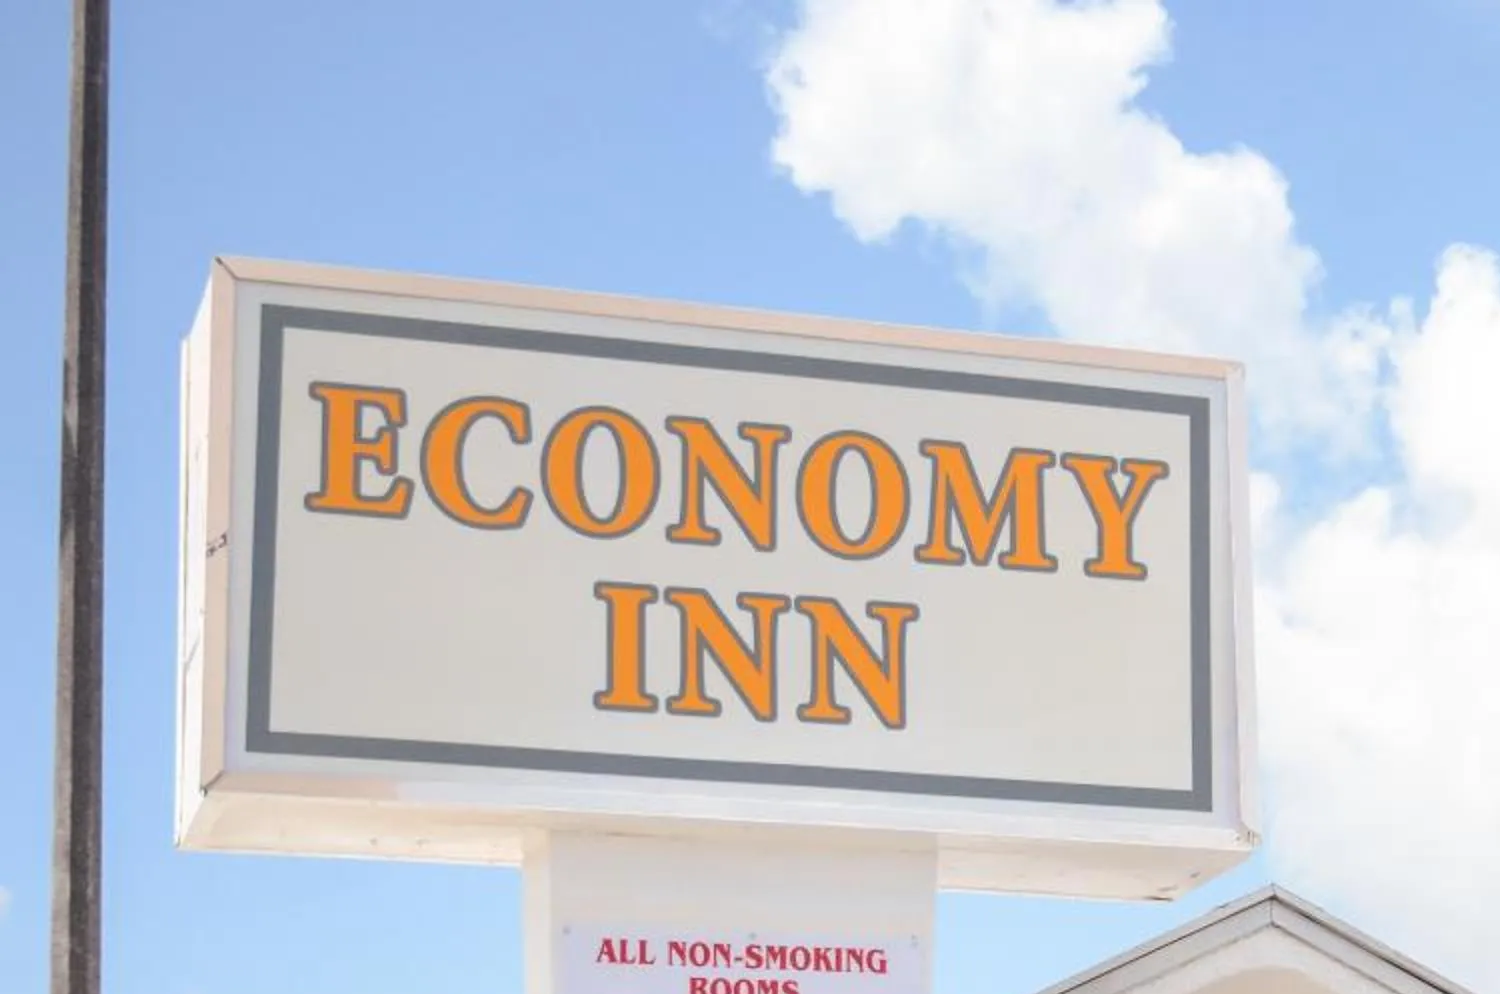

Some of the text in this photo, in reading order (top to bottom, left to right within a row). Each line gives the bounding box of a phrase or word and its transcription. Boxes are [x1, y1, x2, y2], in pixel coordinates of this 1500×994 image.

[304, 380, 1170, 582] ECONOMY
[593, 580, 921, 731] INN
[596, 938, 889, 975] ALL NON-SMOKING
